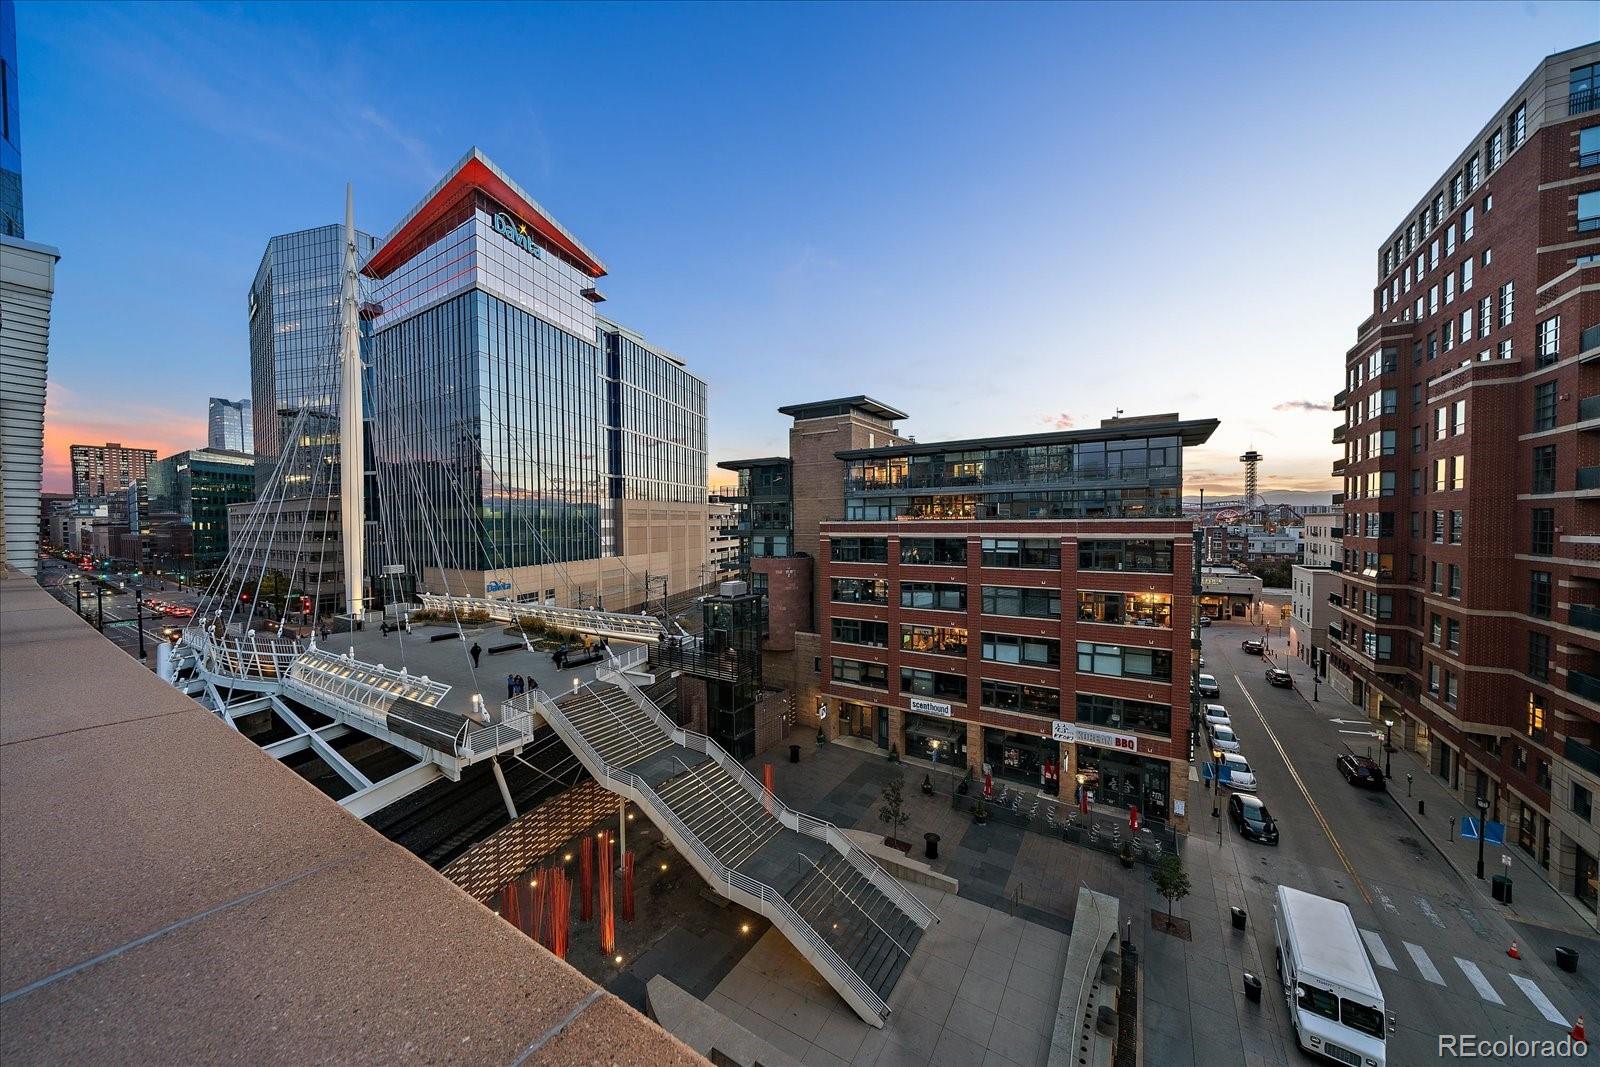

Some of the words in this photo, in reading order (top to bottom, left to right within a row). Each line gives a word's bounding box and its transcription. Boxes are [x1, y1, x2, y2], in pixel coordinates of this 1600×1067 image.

[912, 701, 949, 714] scenthound
[1076, 730, 1113, 746] KOREAN
[1115, 737, 1134, 750] BBQ
